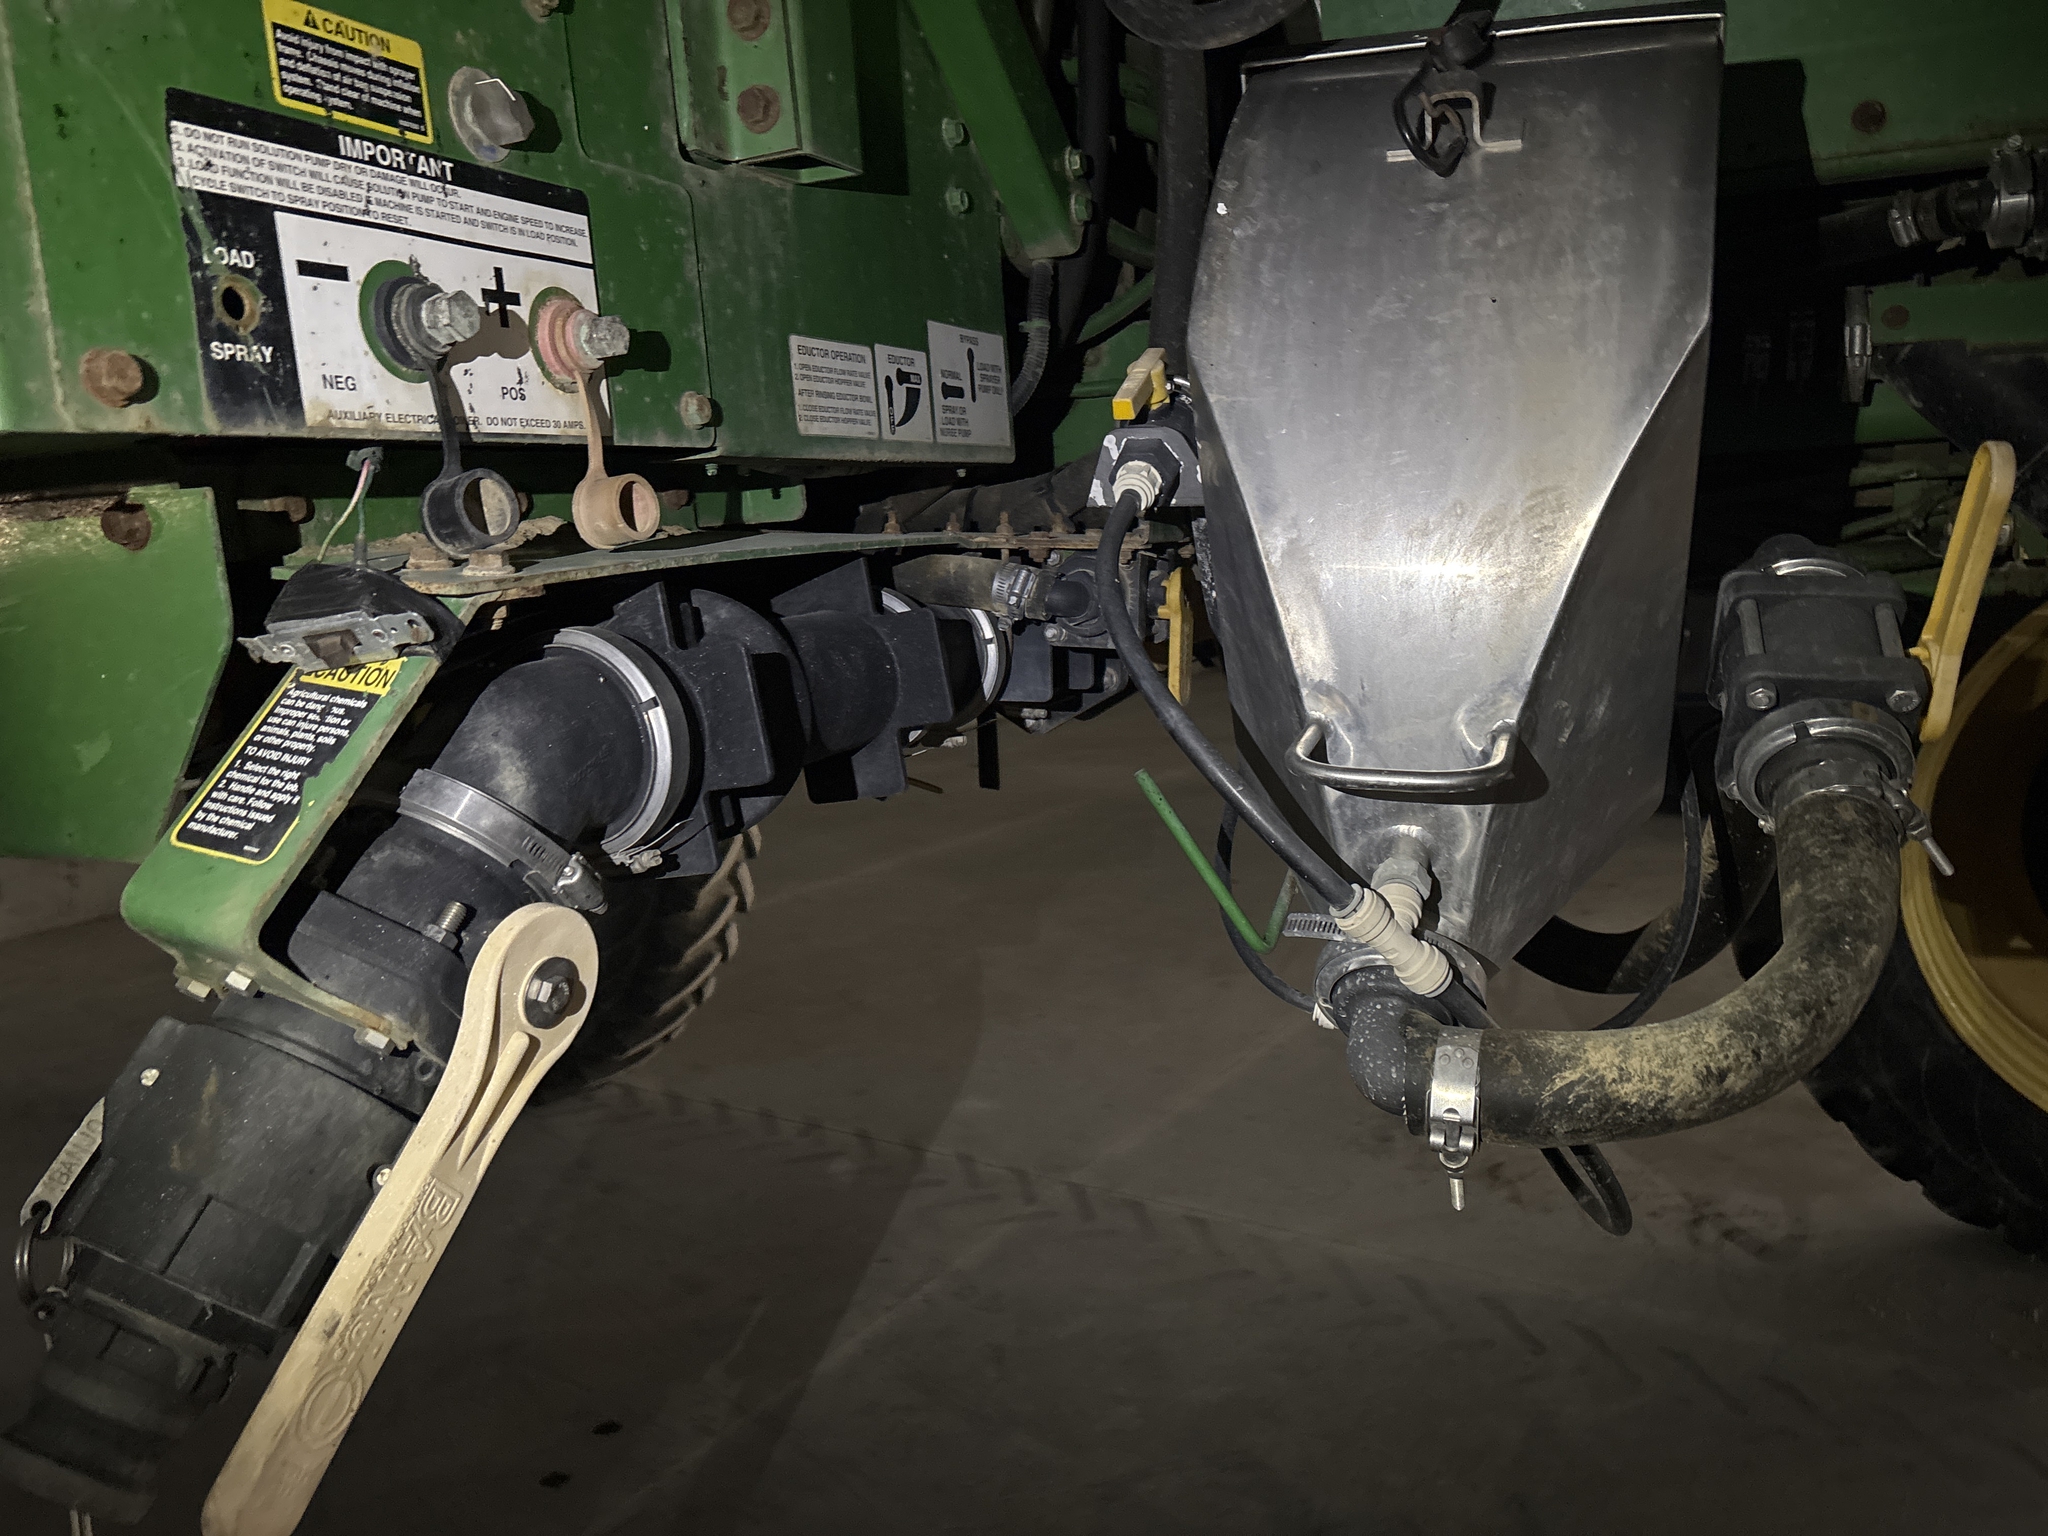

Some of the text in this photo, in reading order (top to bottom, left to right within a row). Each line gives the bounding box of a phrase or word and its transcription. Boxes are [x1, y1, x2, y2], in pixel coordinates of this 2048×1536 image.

[322, 18, 392, 53] CAUTION
[184, 127, 201, 141] DO
[203, 132, 226, 146] NOT
[228, 137, 250, 151] RUN
[251, 142, 302, 163] SOLUTION
[305, 155, 330, 169] PUMP
[332, 161, 352, 174] DRY
[354, 166, 368, 178] OR
[370, 169, 408, 187] DAMAGE
[410, 179, 430, 191] WILL
[431, 183, 462, 199] OCCUR.
[187, 144, 250, 165] ACTIVATION
[252, 158, 266, 168] OF
[268, 162, 306, 177] SWITCH
[308, 170, 332, 182] WILL
[334, 176, 365, 189] CAUSE
[366, 183, 410, 199] SOLUTION
[412, 193, 434, 204] PUMP
[437, 198, 448, 207] TO
[450, 201, 474, 213] START
[476, 207, 492, 217] AND
[493, 210, 520, 222] ENGINE
[520, 216, 544, 228] SPEED
[544, 221, 554, 230] TO
[555, 224, 588, 237] INCREASE.
[192, 175, 412, 227] CYCLE SWITCH TO SPRAY POSITION TO RESET.
[188, 159, 219, 173] LOAD
[222, 166, 274, 184] FUNCTION
[275, 177, 300, 190] WILL
[302, 183, 315, 193] BE
[316, 186, 362, 203] DISABLED
[374, 198, 414, 213] MACHINE
[416, 206, 424, 215] IS
[426, 208, 462, 223] STARTED
[464, 216, 480, 226] AND
[480, 219, 509, 232] SWITCH
[510, 226, 517, 234] IS
[518, 227, 526, 236] IN
[526, 229, 546, 240] LOAD
[546, 233, 578, 247] POSITION.
[959, 334, 979, 346] BYPASS
[210, 341, 274, 364] SPRAY
[797, 344, 866, 364] EDUCTOR OPERATION
[887, 354, 915, 367] EDUCTOR
[799, 363, 811, 371] OPEN
[812, 365, 833, 374] EDUCTOR
[834, 368, 846, 376] FLOW
[847, 369, 858, 377] RATE
[858, 371, 871, 379] VALVE
[813, 375, 834, 383] EDUCTOR
[835, 378, 852, 386] HOPPER
[853, 380, 865, 388] VALVE
[941, 369, 962, 380] NORMAL
[322, 374, 357, 392] NEG
[501, 386, 526, 401] POS
[798, 389, 814, 397] AFTER
[836, 392, 858, 401] EDUCTOR
[328, 409, 382, 424] AUXILIARY
[386, 412, 440, 426] ELECTRICA
[486, 416, 498, 426] DO
[500, 416, 518, 428] NOT
[520, 418, 550, 429] EXCEED
[552, 419, 562, 429] 30
[563, 420, 586, 430] AMPS.
[942, 405, 966, 415] SPRAY OR
[280, 698, 346, 715] can be dangous.
[287, 688, 368, 709] Agricultural chemicals
[267, 716, 350, 738] use can injure persons,
[273, 706, 307, 721] Improper
[341, 718, 352, 727] or
[253, 734, 316, 754] or other property.
[260, 725, 337, 746] animals, plants, soils
[244, 746, 313, 767] TO AVOID INJURY
[234, 759, 301, 781] 1. Select the right
[217, 779, 301, 805] 2. Handle and apply it
[225, 770, 299, 793] chemical for the job.
[210, 790, 275, 811] with care. Follow
[194, 810, 257, 831] by the chemical
[202, 800, 277, 824] instructions issued
[186, 821, 240, 840] manufacturer.
